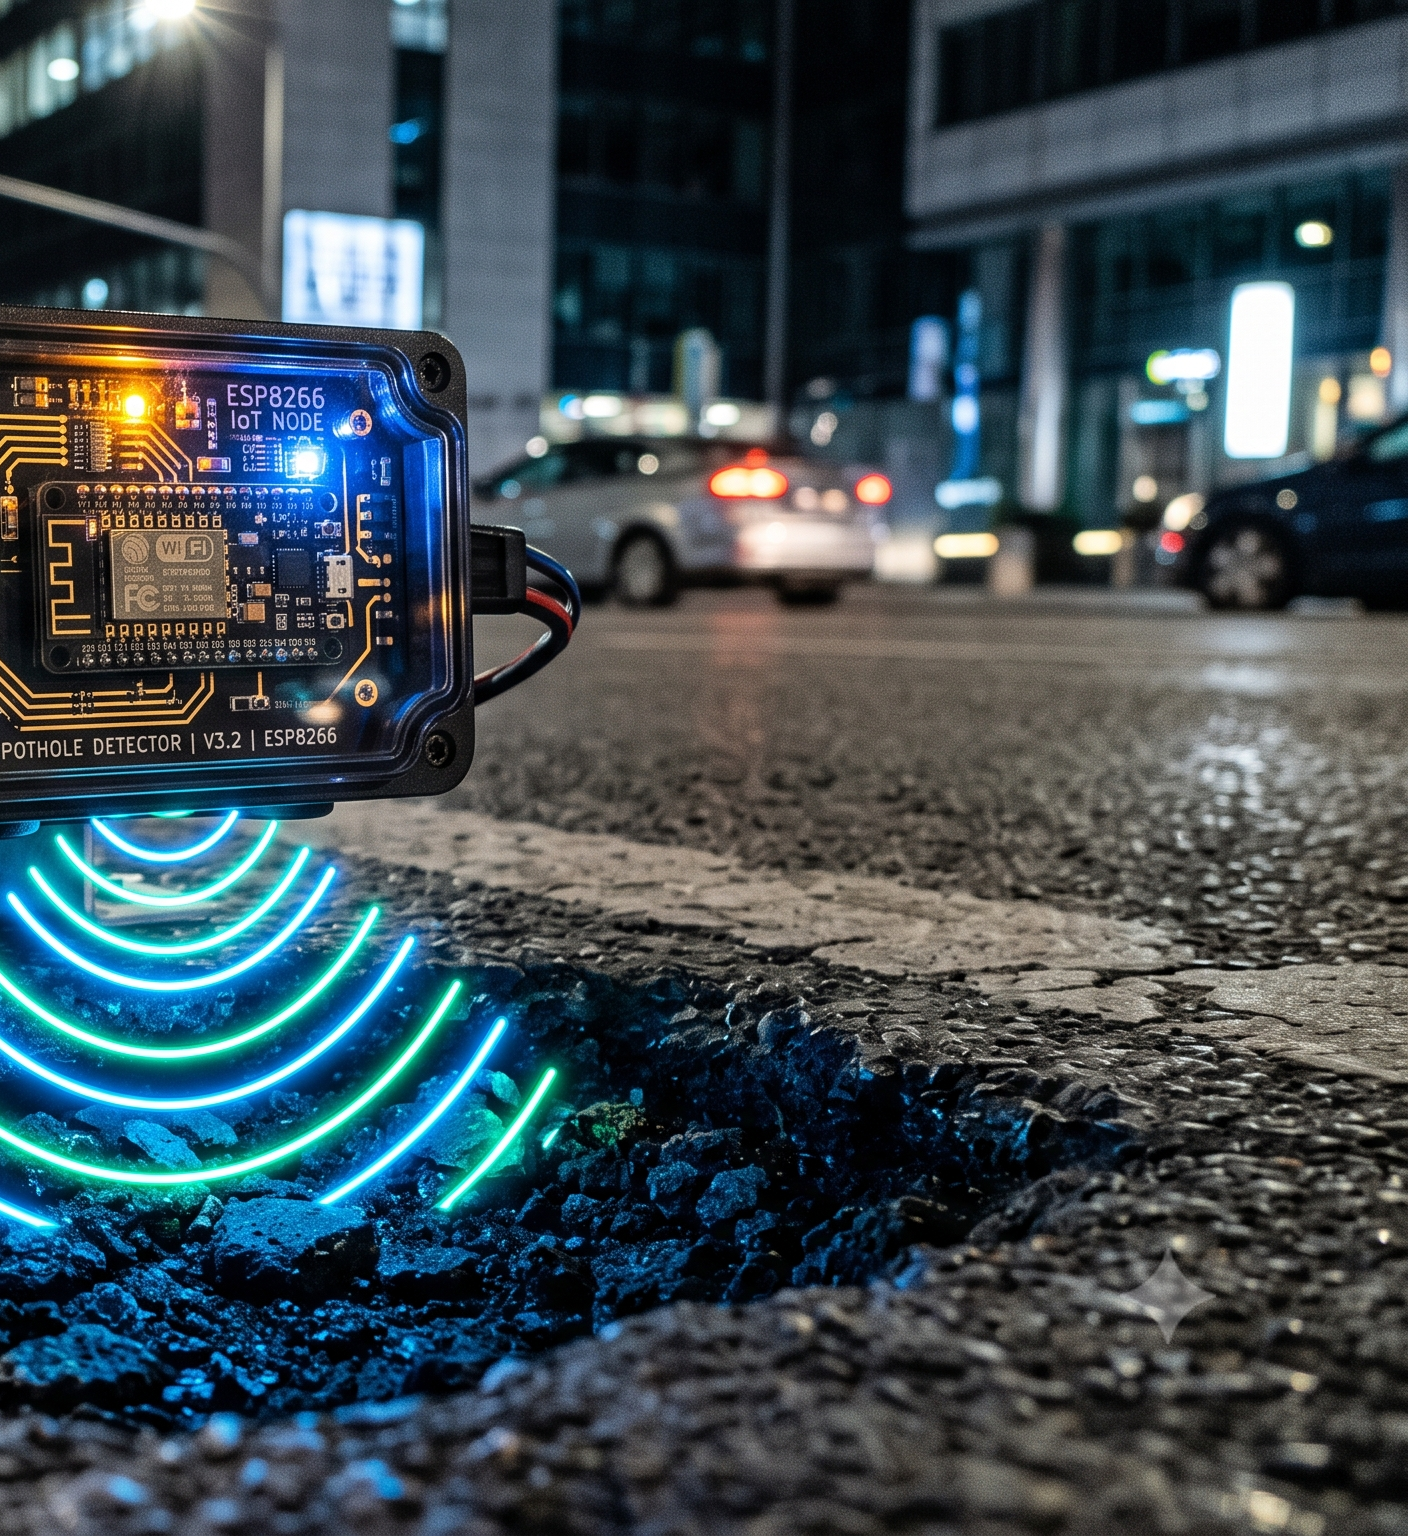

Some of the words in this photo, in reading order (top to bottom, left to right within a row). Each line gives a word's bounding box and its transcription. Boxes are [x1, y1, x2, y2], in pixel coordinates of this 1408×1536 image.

[227, 384, 325, 410] ESP8266
[231, 409, 263, 430] IoT
[272, 411, 324, 432] NODE
[1, 738, 84, 760] POTHOLE
[92, 732, 182, 757] DETECTOR
[203, 731, 242, 750] V3.2
[264, 726, 338, 748] ESP8266
